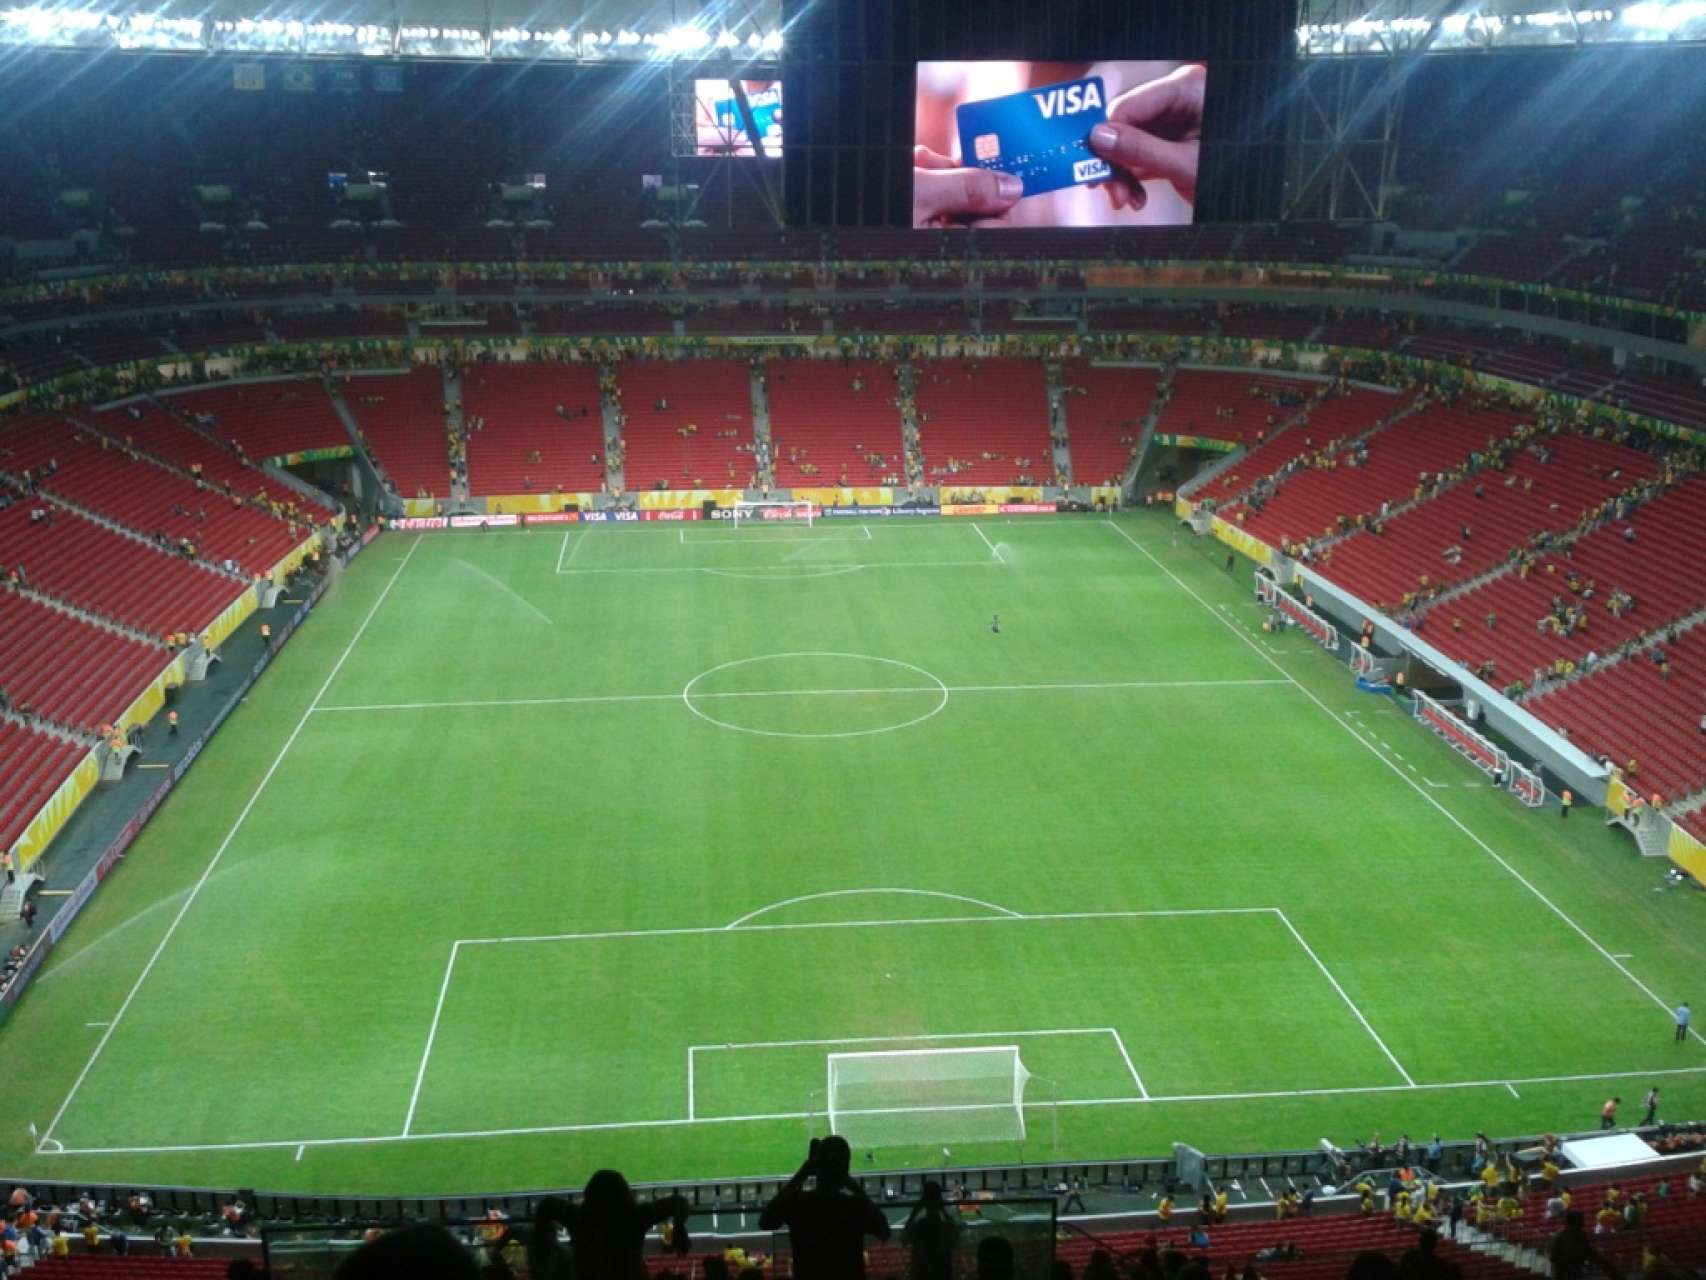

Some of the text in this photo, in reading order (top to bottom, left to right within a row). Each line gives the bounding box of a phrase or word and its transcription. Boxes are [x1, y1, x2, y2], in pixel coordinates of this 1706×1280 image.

[1033, 83, 1101, 118] VISA
[1079, 162, 1110, 177] VISA
[584, 512, 607, 521] VISA
[615, 511, 638, 520] VISA
[711, 509, 753, 519] SONY
